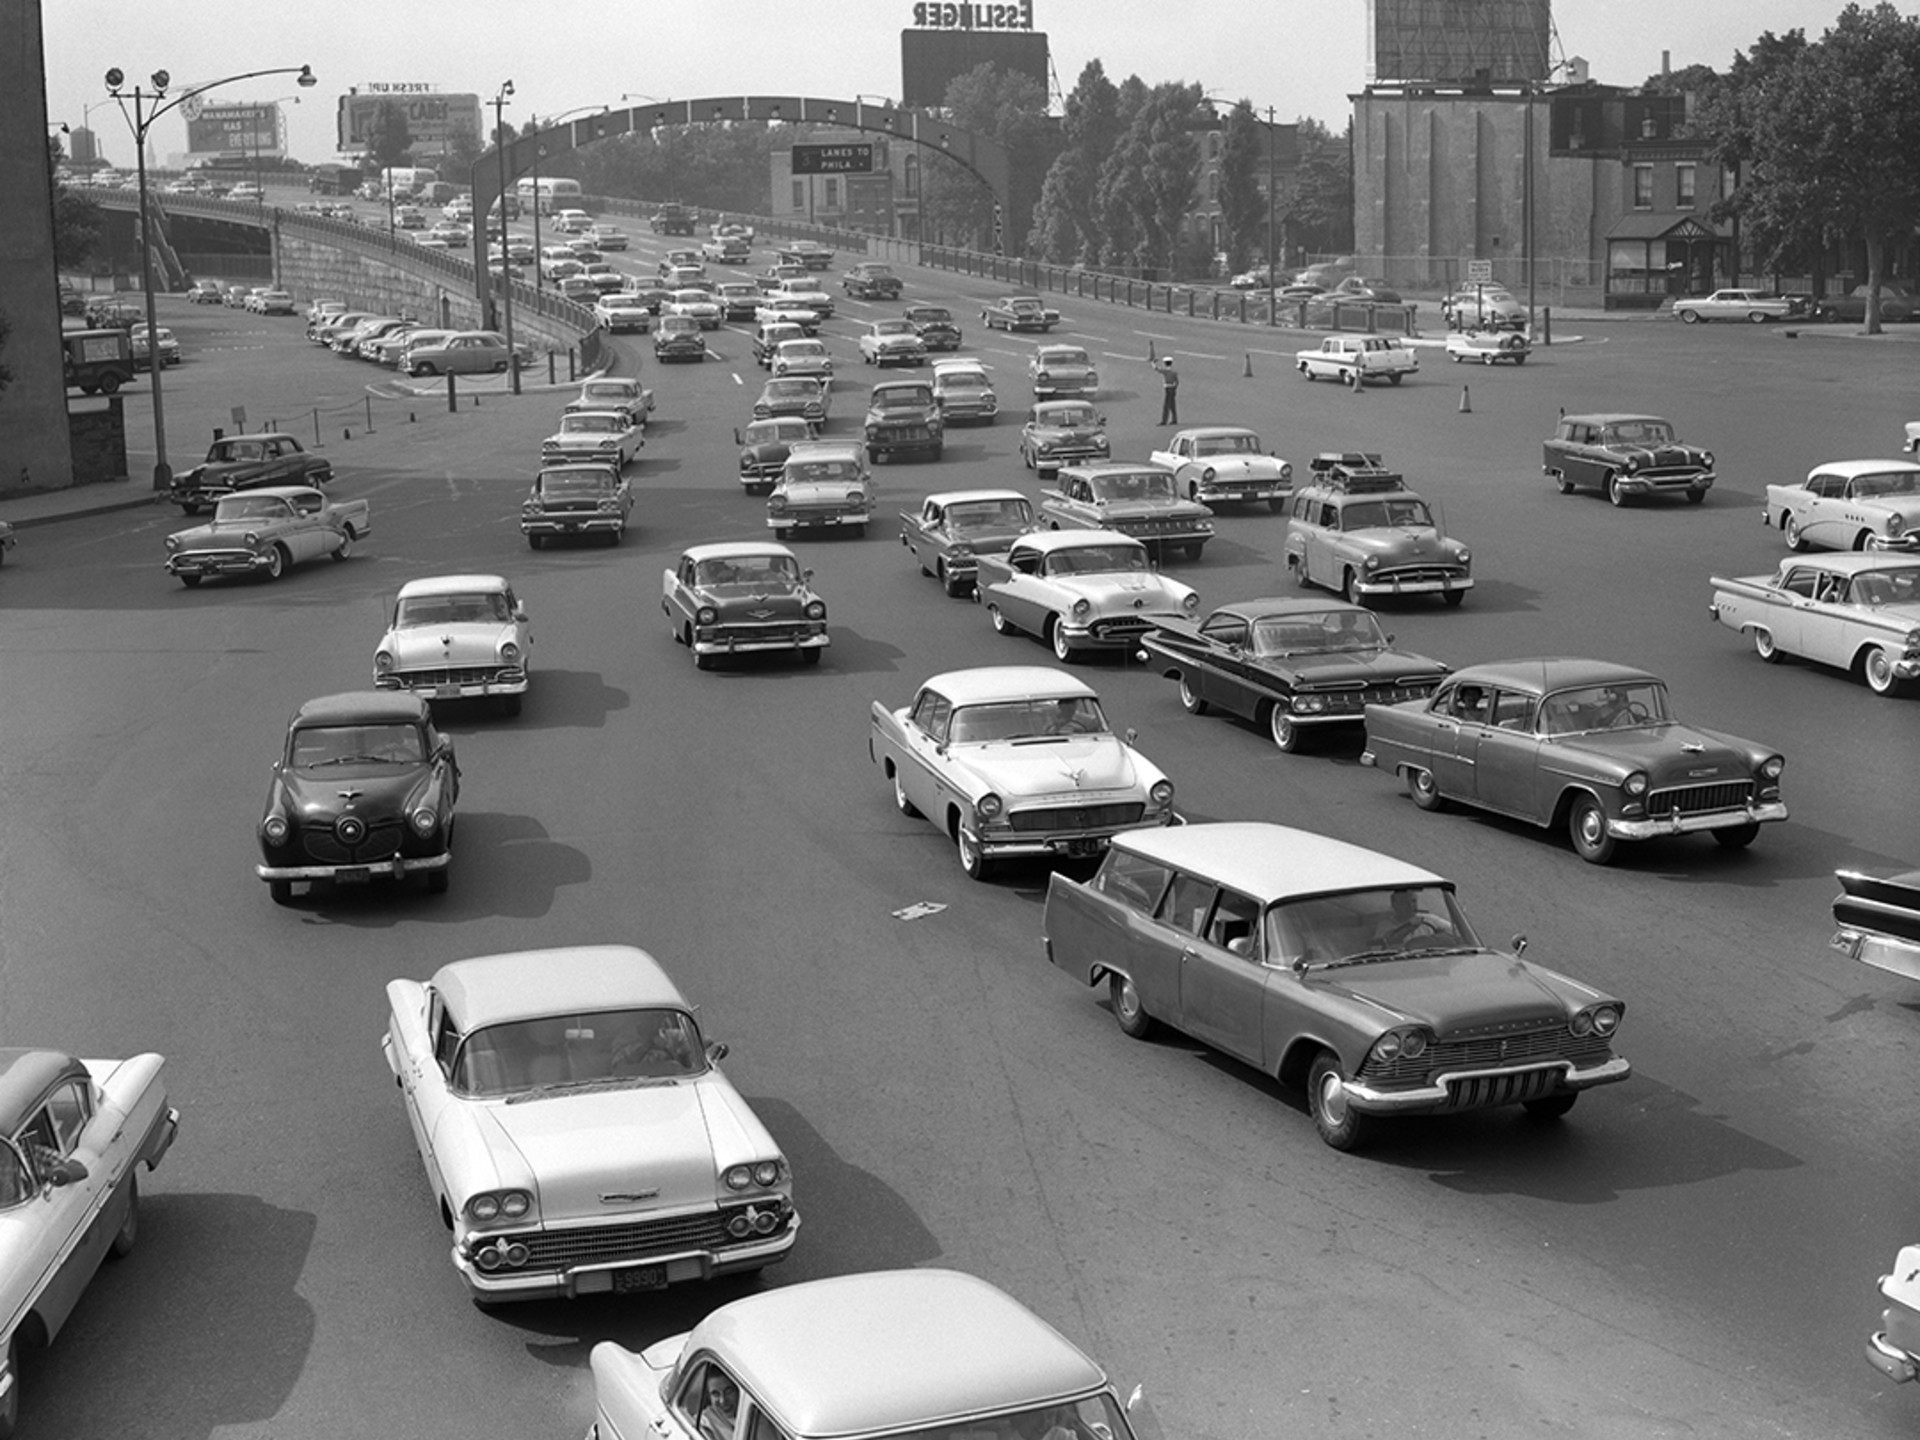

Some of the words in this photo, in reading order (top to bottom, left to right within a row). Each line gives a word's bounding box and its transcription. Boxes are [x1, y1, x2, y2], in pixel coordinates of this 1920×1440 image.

[223, 121, 241, 131] HAS
[821, 148, 853, 157] LANES
[857, 147, 870, 157] TO
